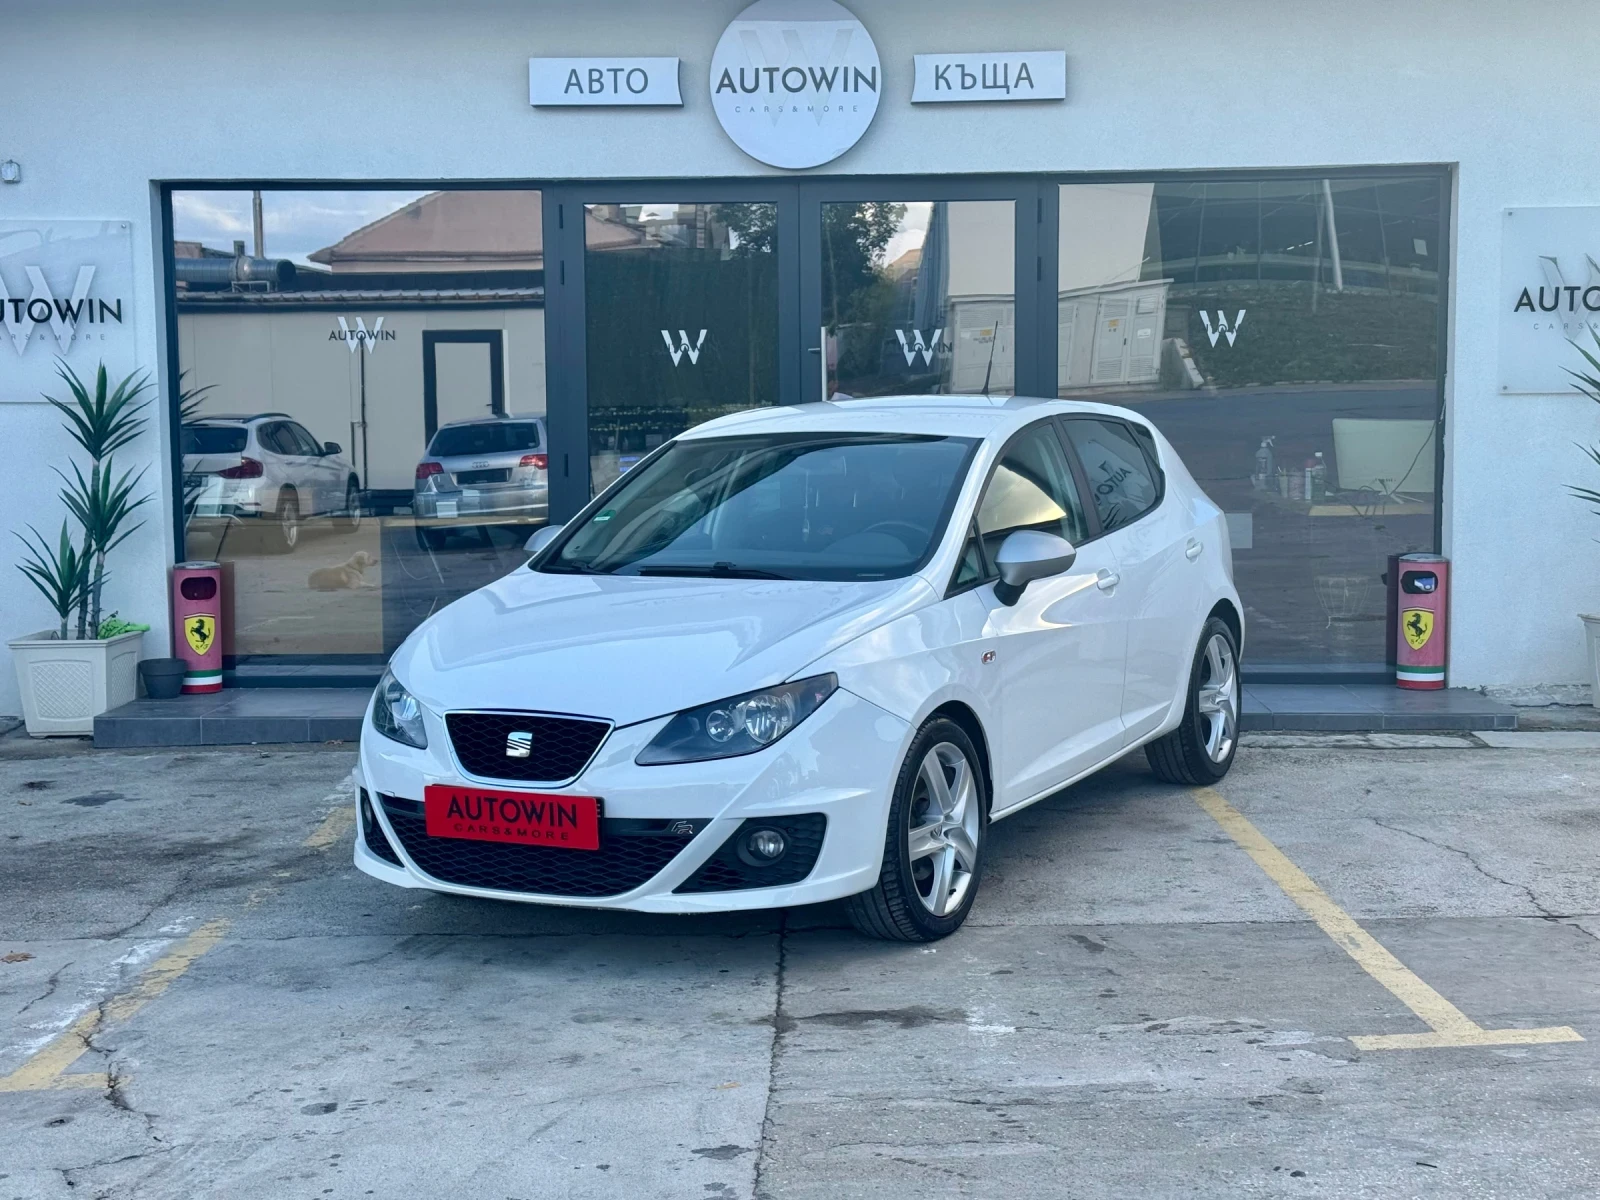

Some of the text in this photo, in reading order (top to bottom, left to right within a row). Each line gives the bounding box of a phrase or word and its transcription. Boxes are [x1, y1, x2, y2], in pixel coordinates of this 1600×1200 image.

[563, 67, 649, 94] АВТО
[715, 66, 877, 94] AUTOWIN
[934, 62, 1035, 95] КЪЩА
[734, 105, 858, 113] CARS&MORE
[0, 298, 122, 324] TOWIN
[328, 329, 396, 341] AUTOWIN
[447, 794, 578, 829] AUTOWIN
[453, 823, 570, 841] CARS&MORE
